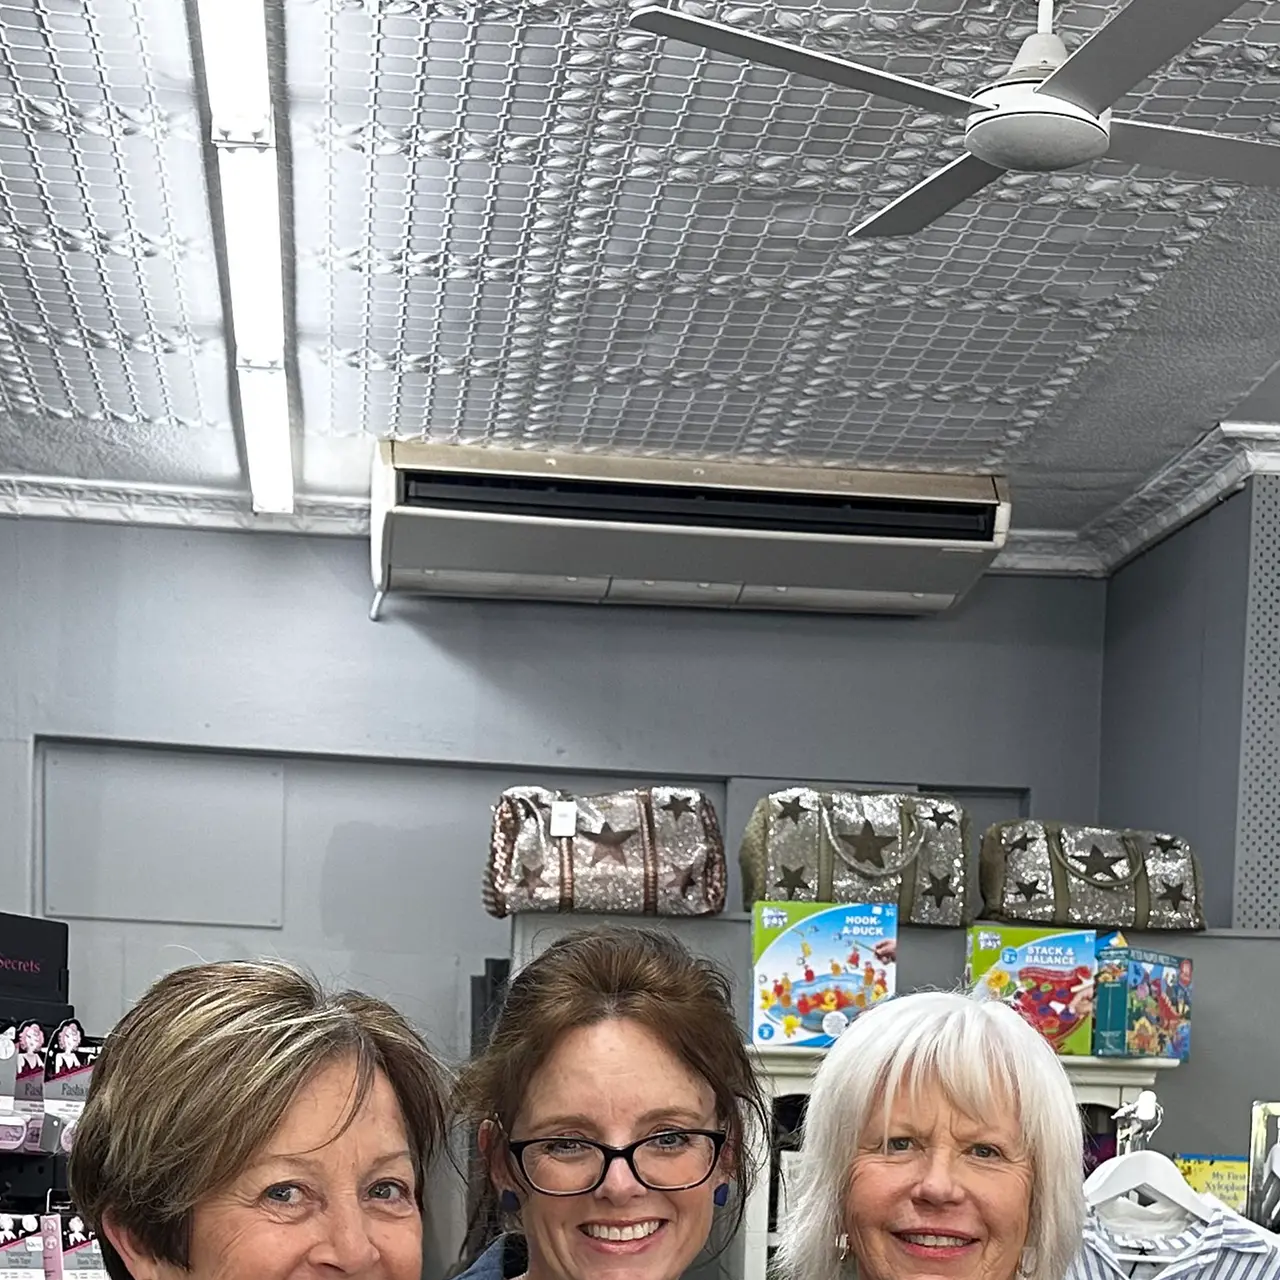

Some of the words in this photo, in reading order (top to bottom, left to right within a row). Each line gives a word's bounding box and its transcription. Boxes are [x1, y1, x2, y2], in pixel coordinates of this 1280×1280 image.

[845, 915, 881, 926] HOOK-
[842, 926, 884, 936] A-DUCK
[1027, 946, 1063, 956] STACK
[1025, 955, 1076, 965] BALANCE
[24, 1082, 43, 1097] Fash
